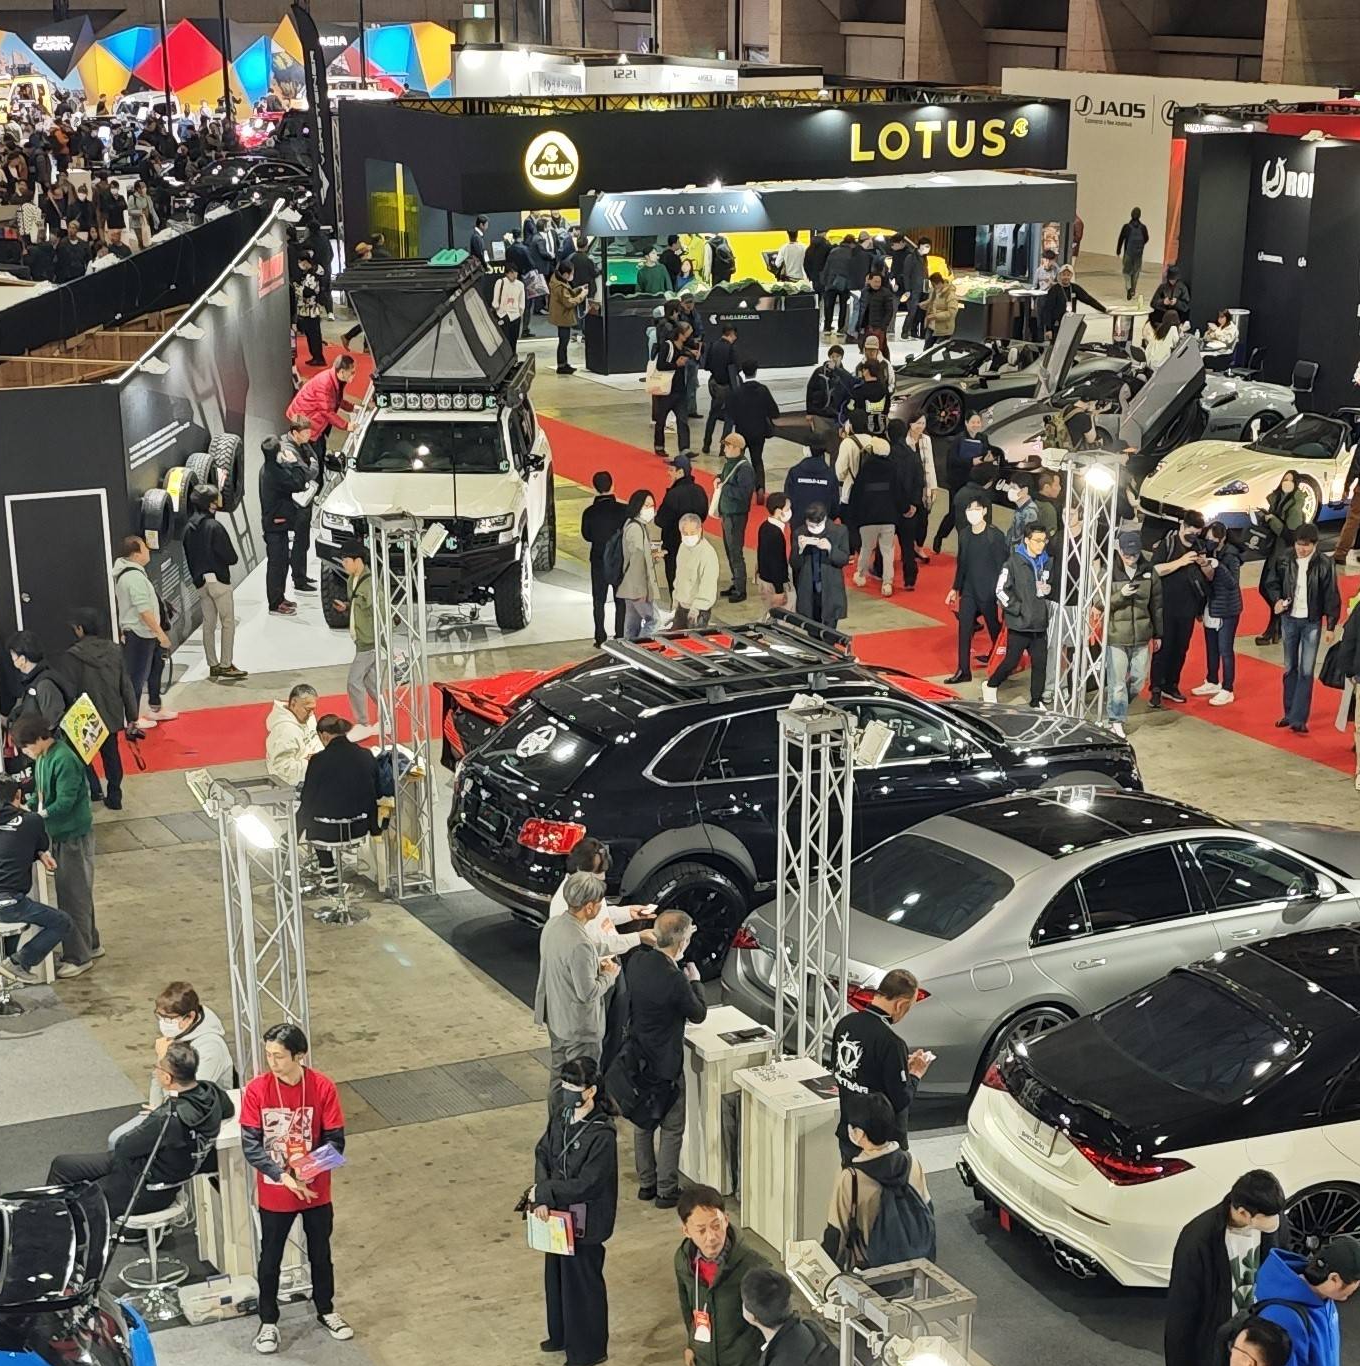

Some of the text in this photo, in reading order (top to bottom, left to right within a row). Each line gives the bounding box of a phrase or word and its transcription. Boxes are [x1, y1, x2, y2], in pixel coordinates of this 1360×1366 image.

[32, 42, 74, 51] CARRY
[1093, 101, 1146, 119] JAOS
[850, 118, 1007, 163] LOTUS
[532, 163, 574, 177] LOTUS
[644, 203, 750, 216] MAGARIGAWA
